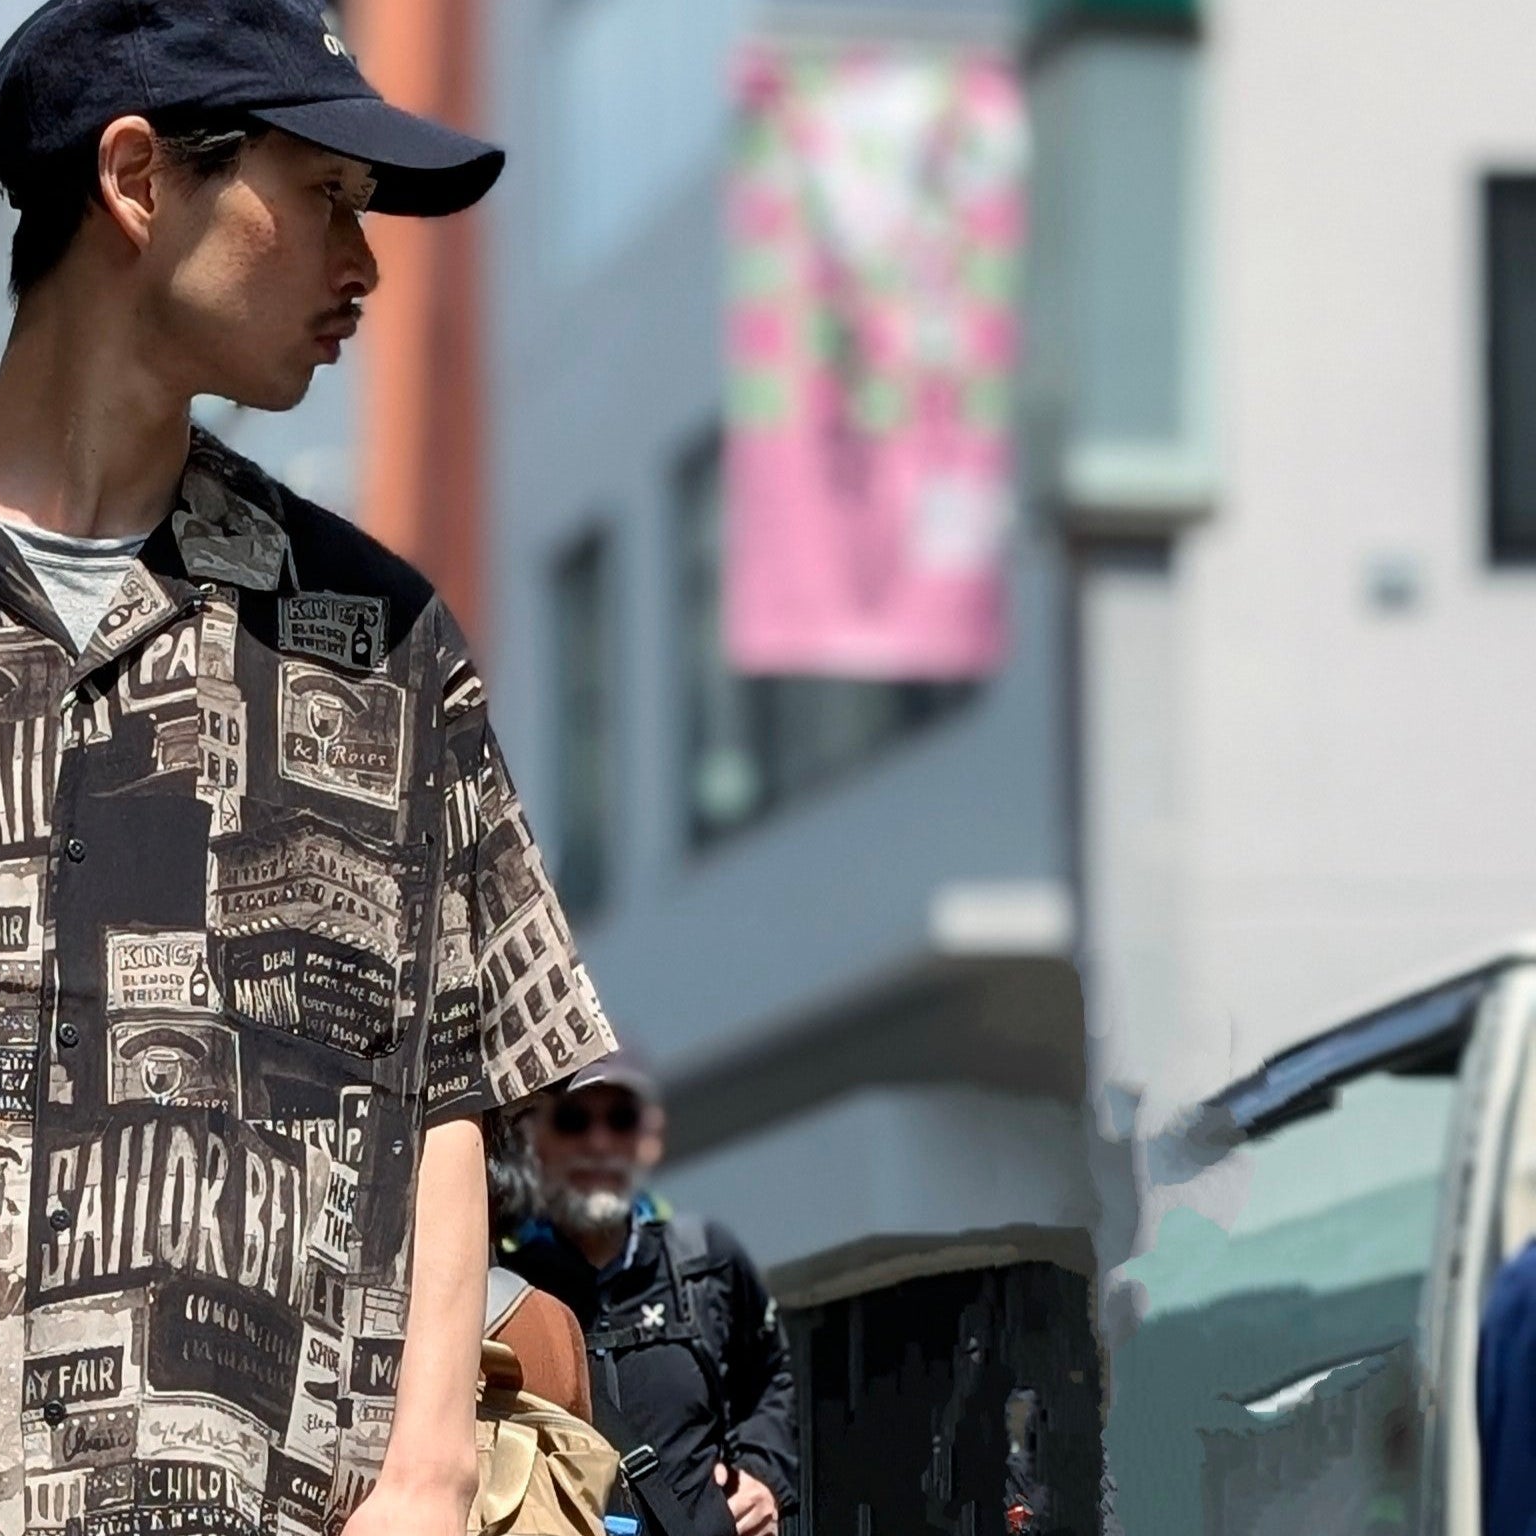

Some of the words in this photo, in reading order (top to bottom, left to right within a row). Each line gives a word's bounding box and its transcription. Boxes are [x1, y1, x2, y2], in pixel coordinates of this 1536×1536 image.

[331, 745, 387, 767] Roses
[262, 947, 296, 972] DEAN
[233, 971, 301, 1029] MARTIN
[39, 1119, 229, 1293] SAILOR
[59, 1356, 115, 1394] FAIR
[148, 1466, 222, 1501] CHILD
